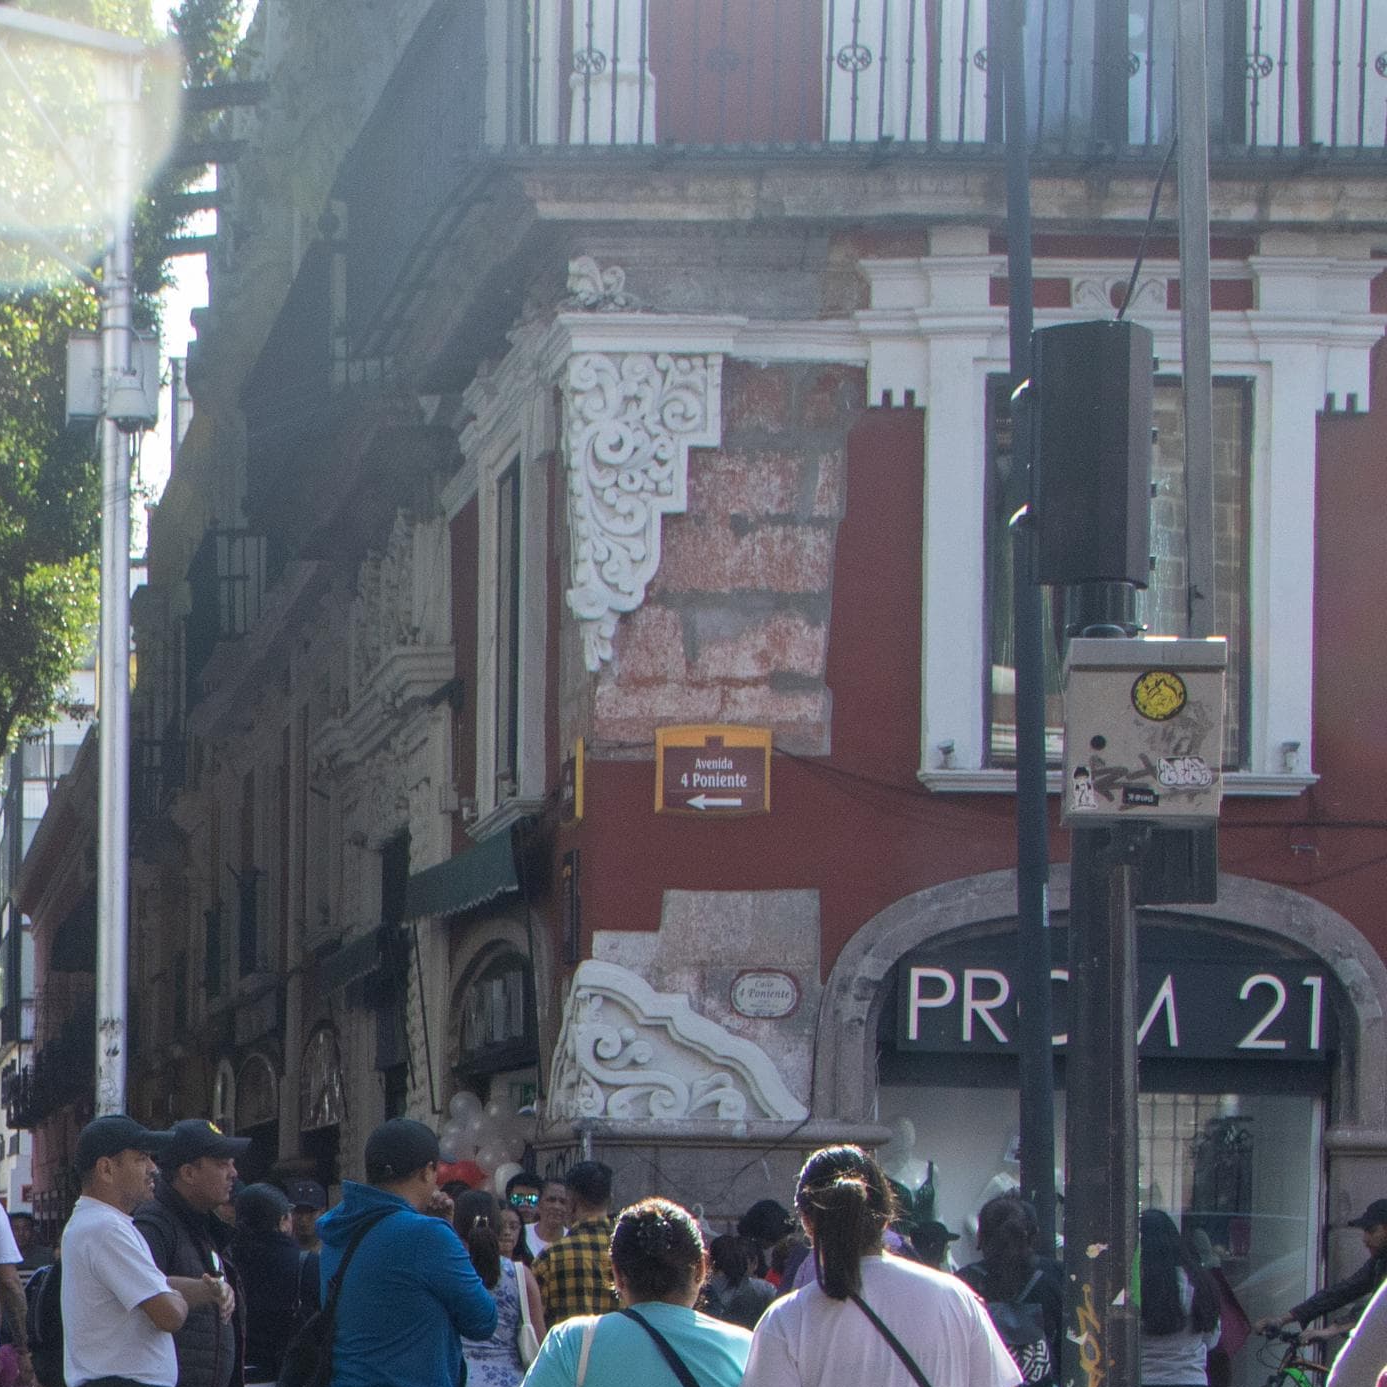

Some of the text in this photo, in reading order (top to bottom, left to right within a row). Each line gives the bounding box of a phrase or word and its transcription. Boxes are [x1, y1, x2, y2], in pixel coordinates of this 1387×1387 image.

[694, 757, 733, 770] Avenida
[680, 771, 748, 788] 4 Poniente
[754, 980, 775, 989] Calle
[749, 988, 791, 999] Poniente
[1236, 972, 1323, 1050] 21
